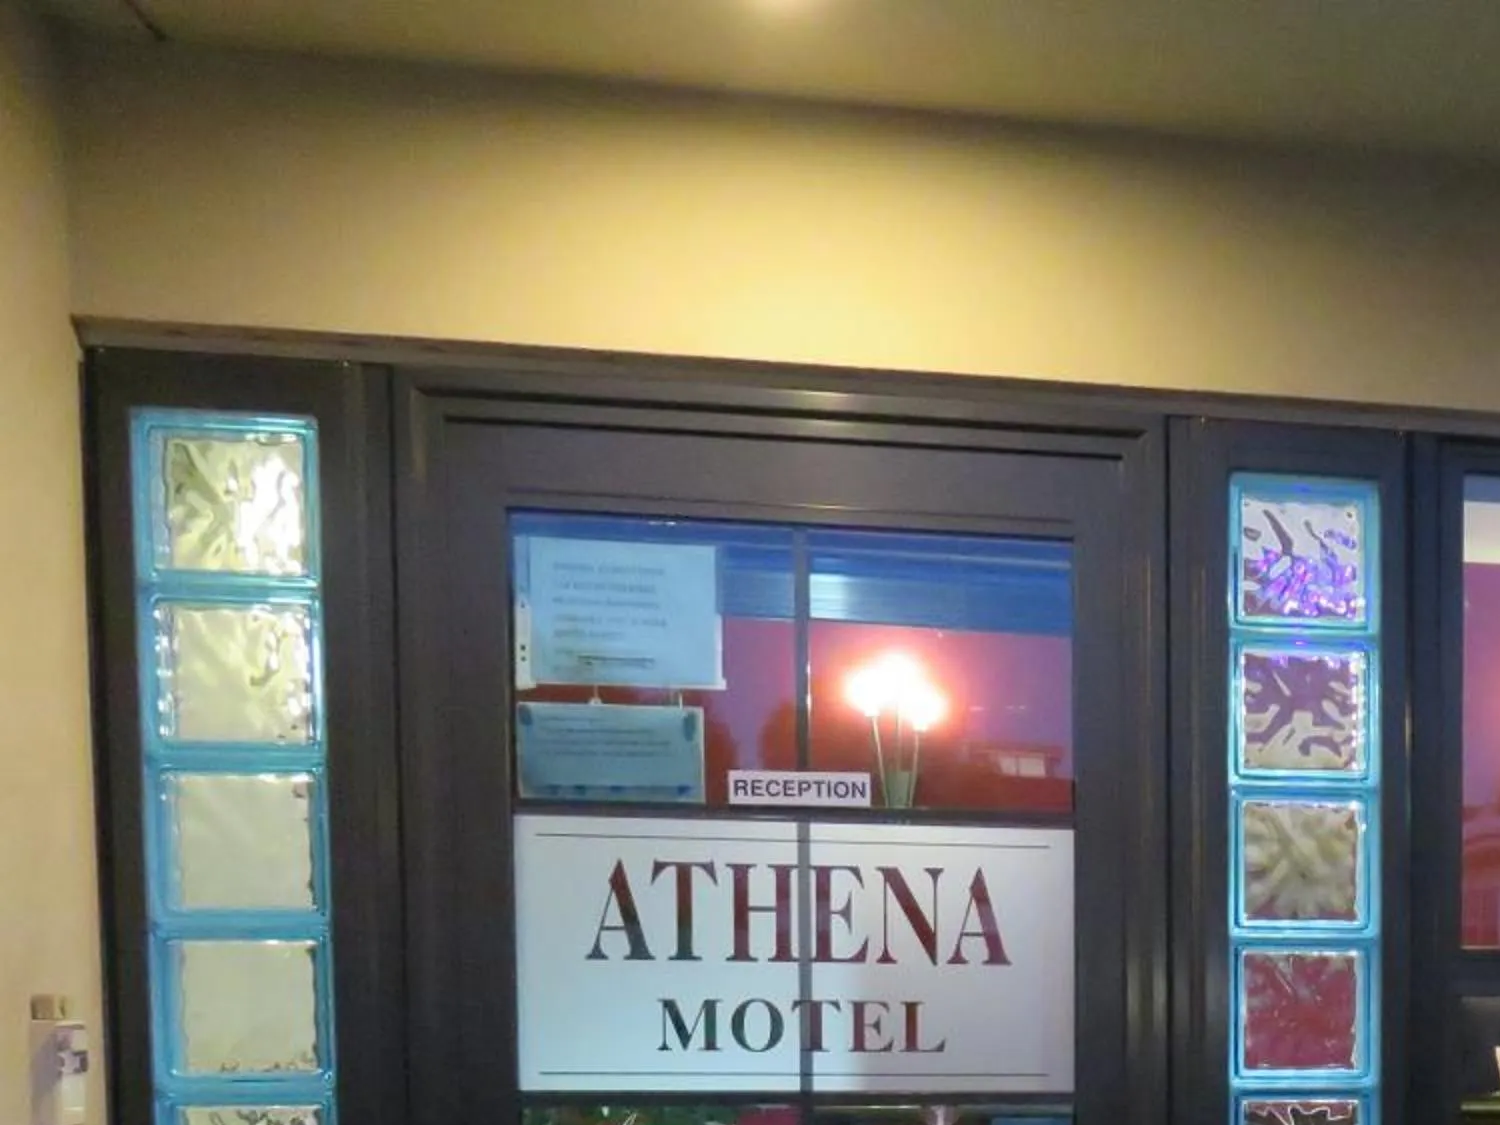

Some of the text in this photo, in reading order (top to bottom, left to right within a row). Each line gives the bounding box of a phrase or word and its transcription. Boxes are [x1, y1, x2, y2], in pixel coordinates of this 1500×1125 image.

[733, 779, 867, 800] RECEPTION
[585, 858, 1012, 966] ATHENA
[657, 997, 947, 1053] MOTEL
